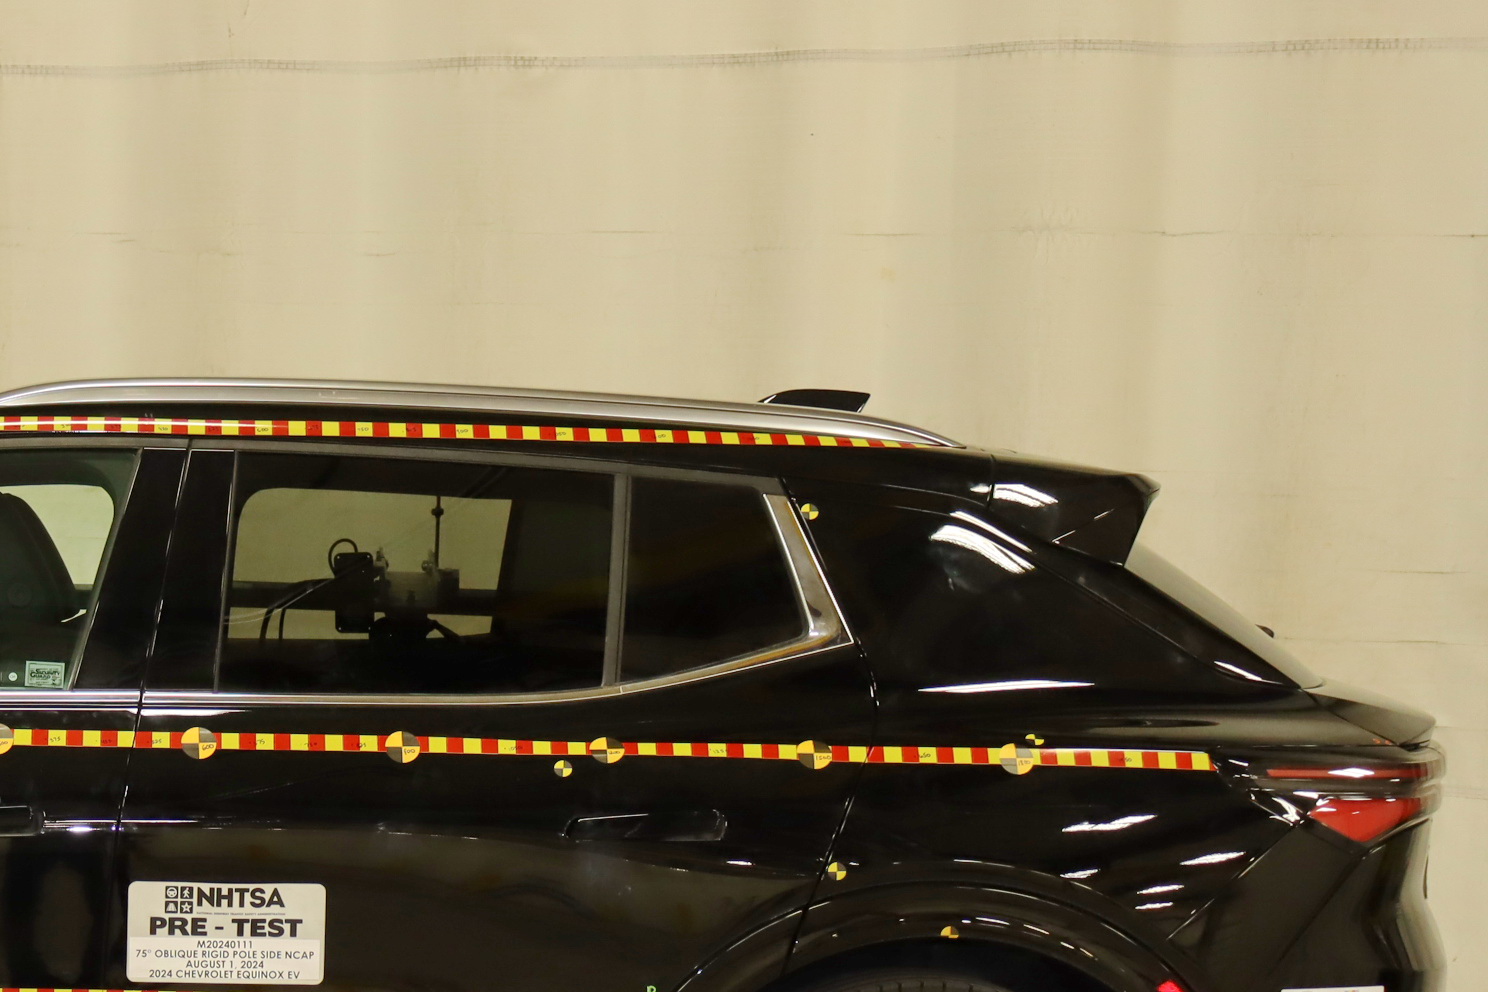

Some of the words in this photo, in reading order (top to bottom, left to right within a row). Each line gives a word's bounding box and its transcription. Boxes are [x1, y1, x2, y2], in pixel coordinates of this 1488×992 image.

[196, 887, 285, 908] NHTSA
[149, 917, 208, 936] PRE
[231, 918, 303, 937] TEST
[196, 940, 253, 949] M20240111
[155, 949, 199, 959] OBLIQUE
[201, 950, 230, 959] RIGID
[233, 950, 258, 959] POLE
[261, 951, 282, 960] SIDE
[285, 951, 315, 960] NCAP
[185, 960, 225, 969] AUGUST
[240, 961, 264, 969] 2024
[149, 969, 173, 978] 2024
[176, 970, 233, 979] CHEVROLET
[236, 970, 284, 980] EQUINOX
[288, 971, 300, 980] EV
